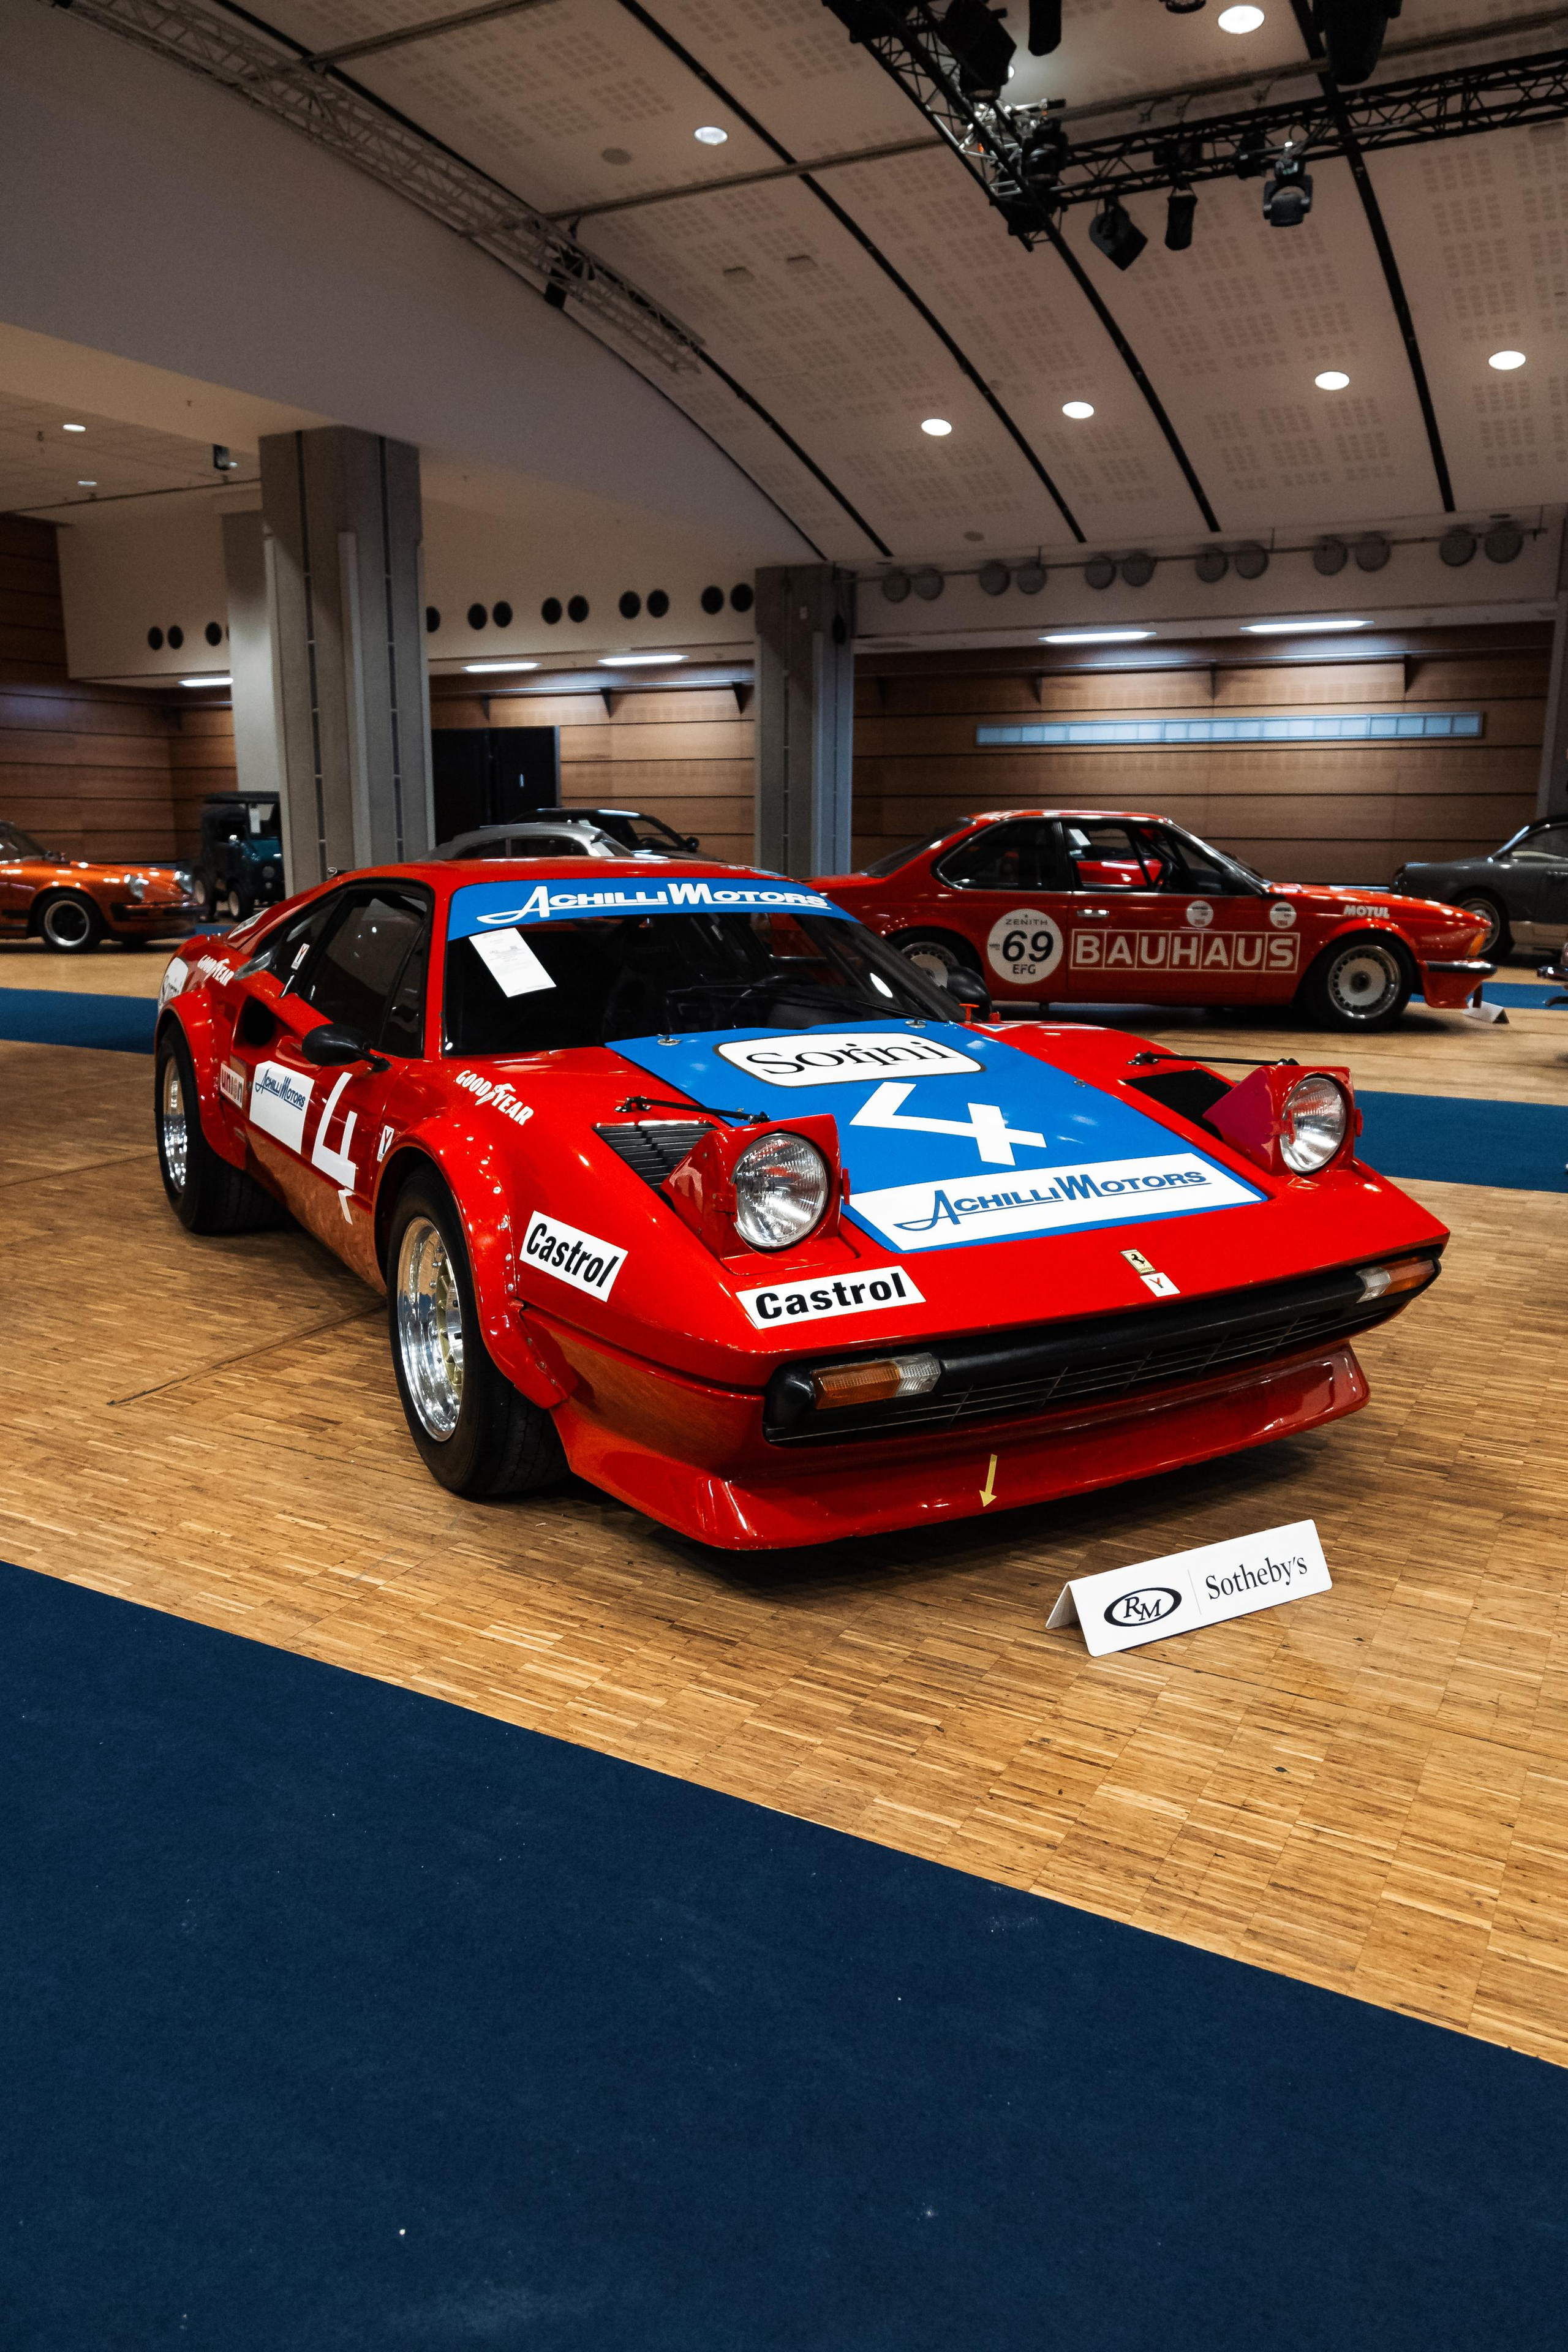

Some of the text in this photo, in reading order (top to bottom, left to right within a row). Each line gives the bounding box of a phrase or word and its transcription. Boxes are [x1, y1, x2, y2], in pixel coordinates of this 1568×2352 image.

[1343, 905, 1390, 919] MOTUL
[1002, 930, 1054, 962] 69
[1012, 964, 1036, 974] EFG
[1075, 935, 1294, 967] BAUHAUS
[746, 1041, 957, 1074] Sorini
[456, 1070, 534, 1126] GOODYEAR
[312, 1072, 356, 1190] 4
[849, 1081, 1047, 1166] 4
[526, 1223, 620, 1288] Castrol
[756, 1272, 907, 1319] Castrol
[1123, 1556, 1308, 1621] RM Sotheby's
